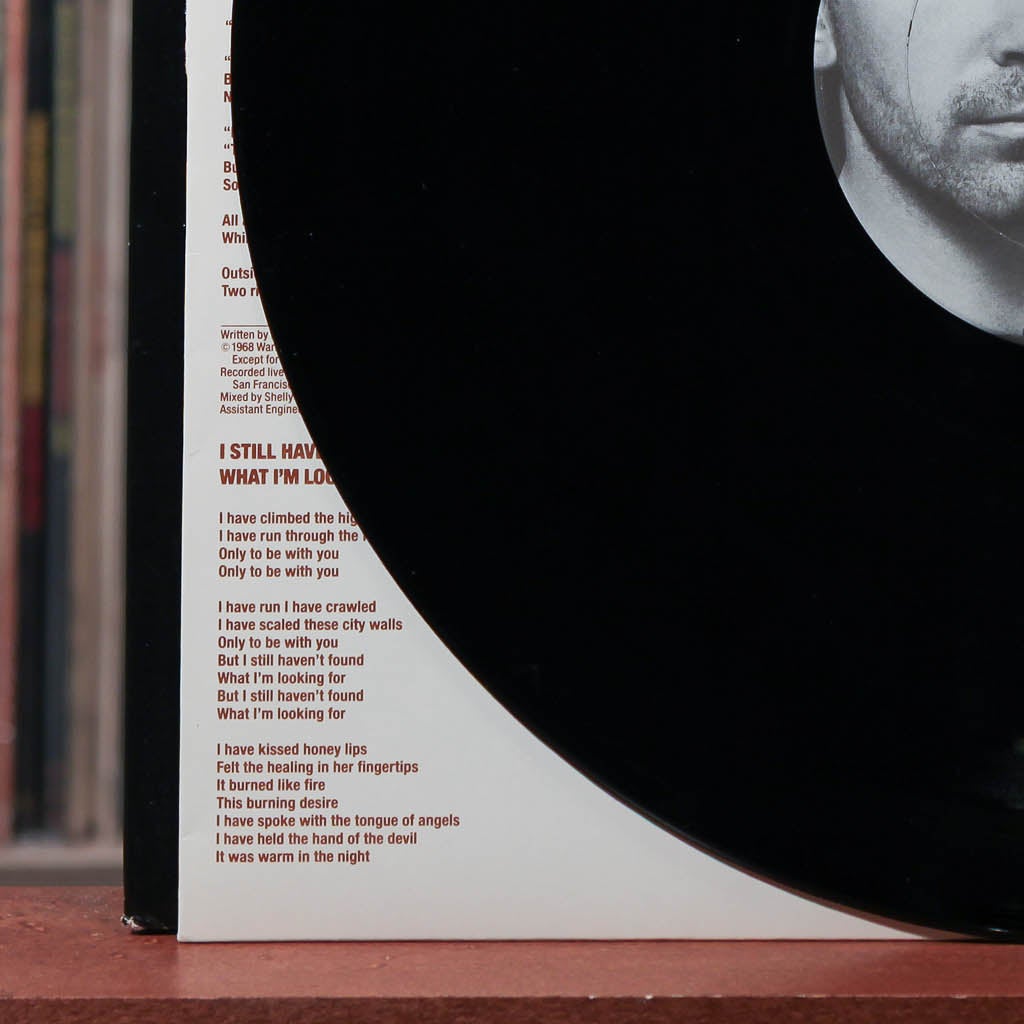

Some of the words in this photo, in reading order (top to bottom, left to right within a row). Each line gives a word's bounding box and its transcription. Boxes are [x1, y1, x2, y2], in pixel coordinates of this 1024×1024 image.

[222, 214, 238, 226] All
[222, 284, 246, 297] Two
[221, 330, 254, 339] Written
[258, 330, 268, 341] by
[232, 343, 254, 352] 1968
[232, 355, 263, 365] Except
[266, 355, 280, 364] for
[221, 368, 265, 377] Recorded
[268, 368, 286, 377] live
[233, 380, 250, 389] San
[253, 380, 290, 389] Francis
[220, 392, 248, 402] Mixed
[251, 392, 262, 403] by
[265, 392, 294, 403] Shelly
[220, 405, 263, 414] Assistant
[220, 443, 225, 459] I
[230, 443, 276, 460] STILL
[220, 469, 269, 484] WHAT
[273, 469, 299, 484] I'M
[218, 619, 221, 630] I
[226, 619, 256, 630] have
[259, 619, 300, 631] scaled
[304, 619, 338, 631] these
[342, 618, 365, 633] city
[369, 618, 403, 631] walls
[217, 744, 220, 755] I
[224, 744, 254, 755] have
[258, 743, 299, 755] kissed
[303, 743, 341, 758] honey
[345, 743, 367, 757] lips
[217, 761, 239, 773] Felt
[243, 761, 263, 773] the
[268, 761, 313, 775] healing
[317, 761, 329, 773] in
[333, 761, 354, 773] her
[358, 760, 418, 775] fingertips
[217, 779, 225, 791] It
[229, 779, 274, 791] burned
[278, 779, 300, 791] like
[304, 779, 325, 791] fire
[217, 797, 243, 809] This
[247, 797, 296, 811] burning
[300, 797, 338, 808] desire
[216, 815, 220, 827] I
[224, 815, 254, 827] have
[258, 815, 295, 829] spoke
[300, 814, 327, 827] with
[331, 814, 351, 826] the
[355, 815, 398, 828] tongue
[402, 814, 415, 826] of
[418, 814, 460, 828] angels
[216, 833, 220, 845] I
[224, 833, 254, 845] have
[257, 833, 284, 845] held
[288, 832, 308, 844] the
[312, 832, 344, 844] hand
[347, 832, 360, 844] of
[364, 832, 384, 844] the
[388, 832, 417, 844] devil
[216, 851, 224, 862] It
[228, 853, 254, 862] was
[258, 852, 294, 862] warm
[298, 851, 310, 862] in
[314, 851, 334, 862] the
[338, 850, 370, 865] night
